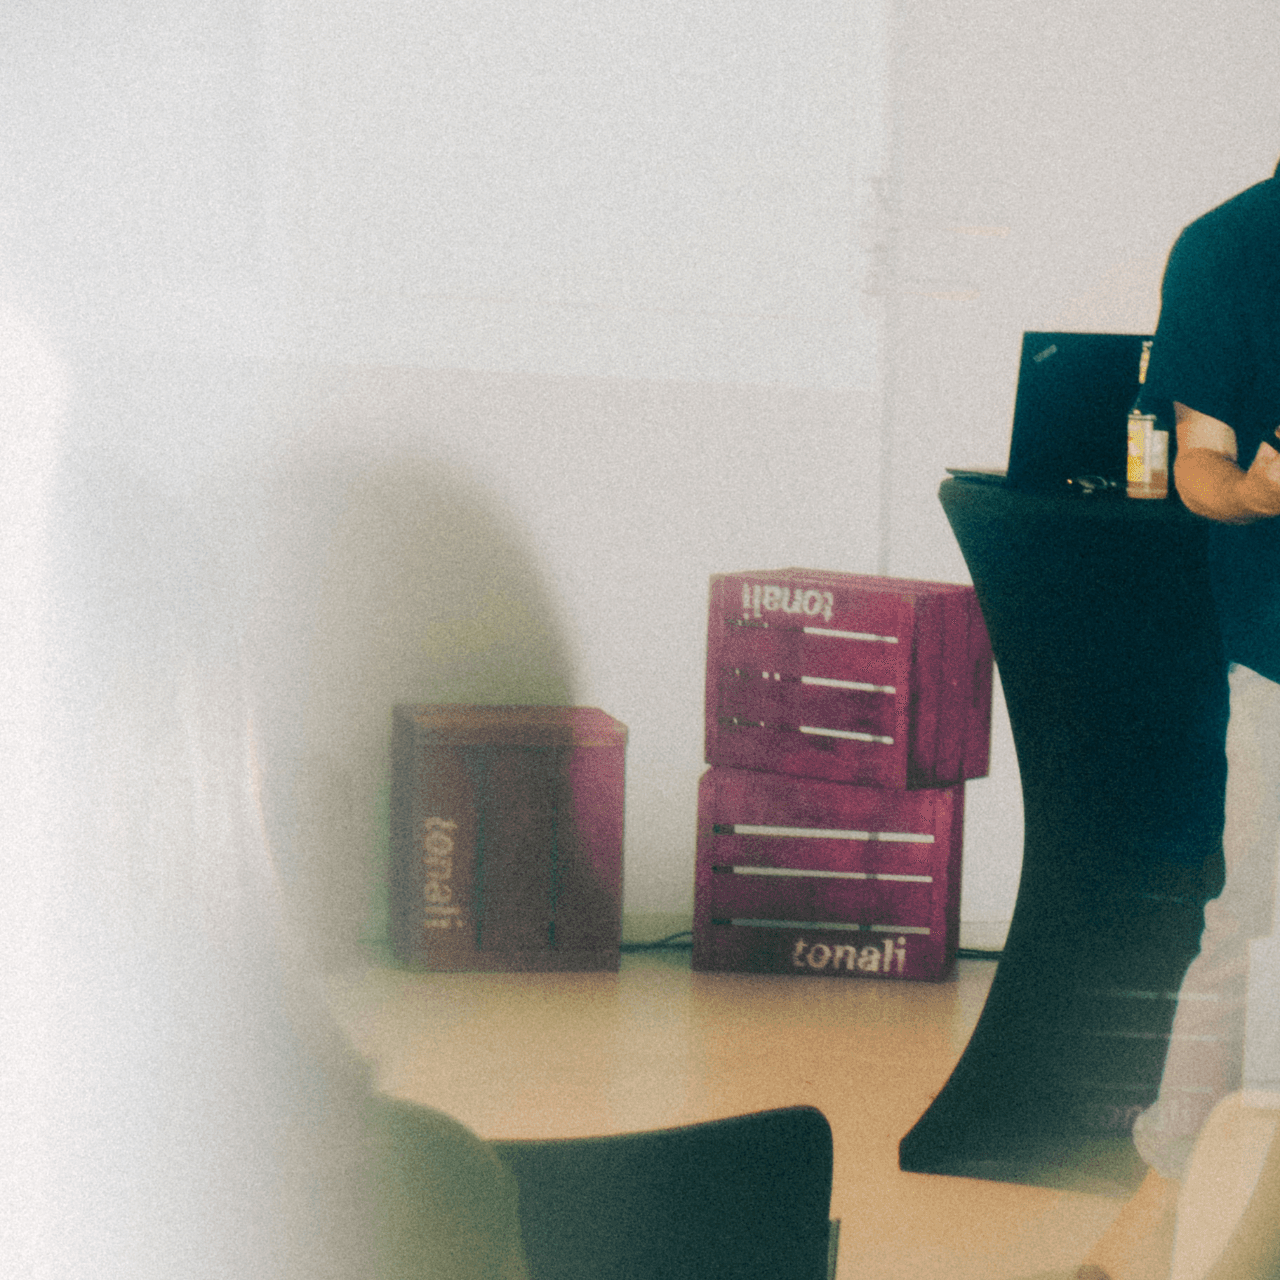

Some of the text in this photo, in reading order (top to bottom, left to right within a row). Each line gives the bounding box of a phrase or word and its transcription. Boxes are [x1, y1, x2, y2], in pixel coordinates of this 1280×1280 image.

[742, 583, 834, 621] tonali
[424, 817, 462, 928] tonali
[793, 936, 906, 972] tonali
